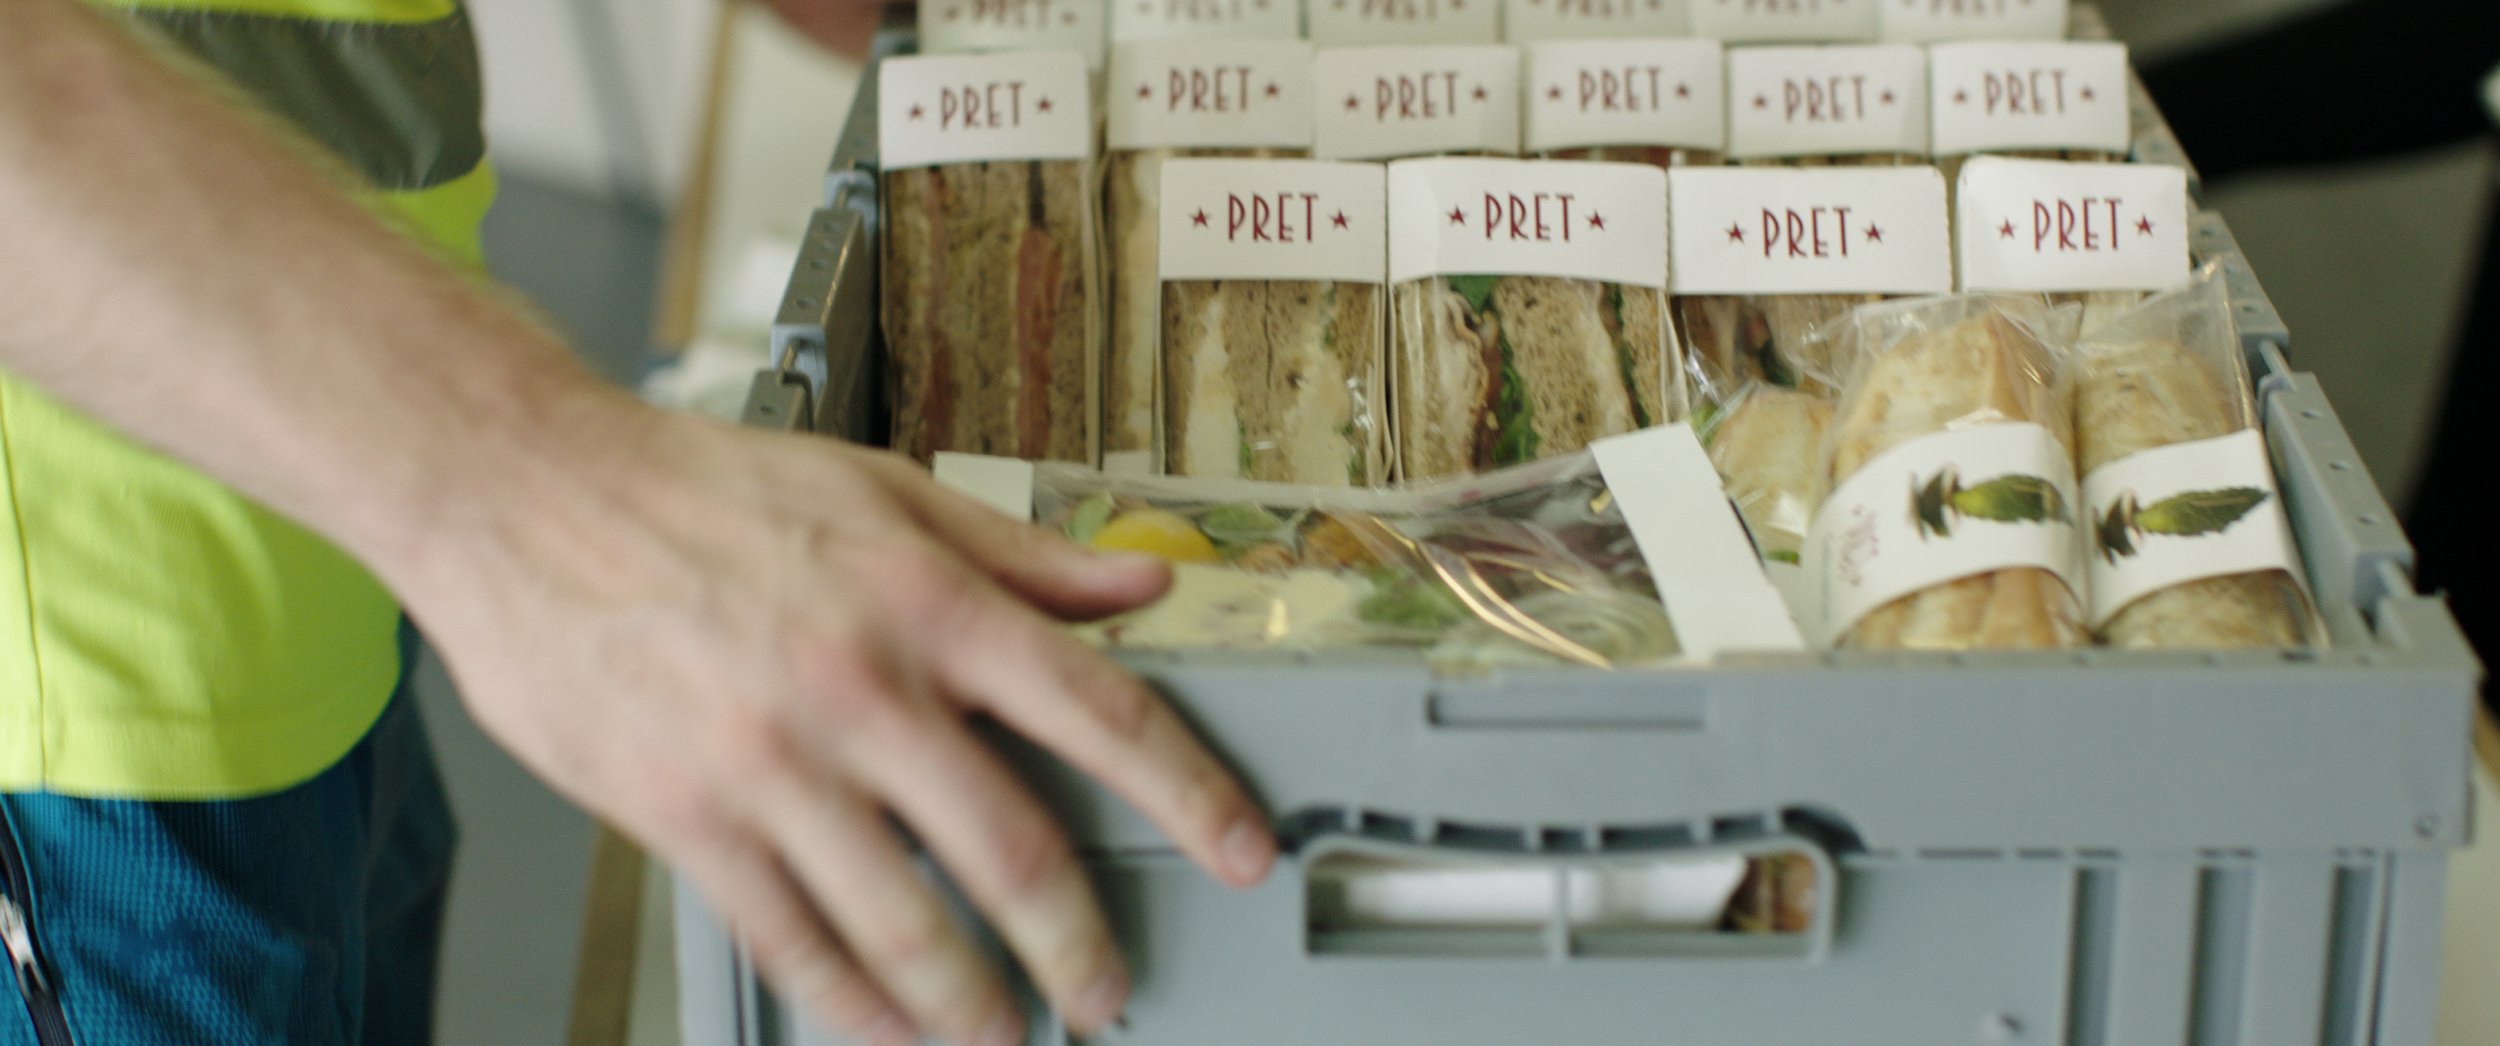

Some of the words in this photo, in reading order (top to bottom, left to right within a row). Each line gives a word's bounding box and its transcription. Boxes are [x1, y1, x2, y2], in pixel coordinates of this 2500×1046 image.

[940, 81, 1024, 130] PRET
[1167, 67, 1252, 114] PRET
[1374, 72, 1459, 121] PRET
[1576, 67, 1661, 113] PRET
[1781, 77, 1865, 122] PRET
[1981, 69, 2065, 115] PRET
[1226, 193, 1318, 243] PRET
[1483, 193, 1574, 242] PRET
[1760, 207, 1851, 258] PRET
[2031, 197, 2122, 252] PRET
